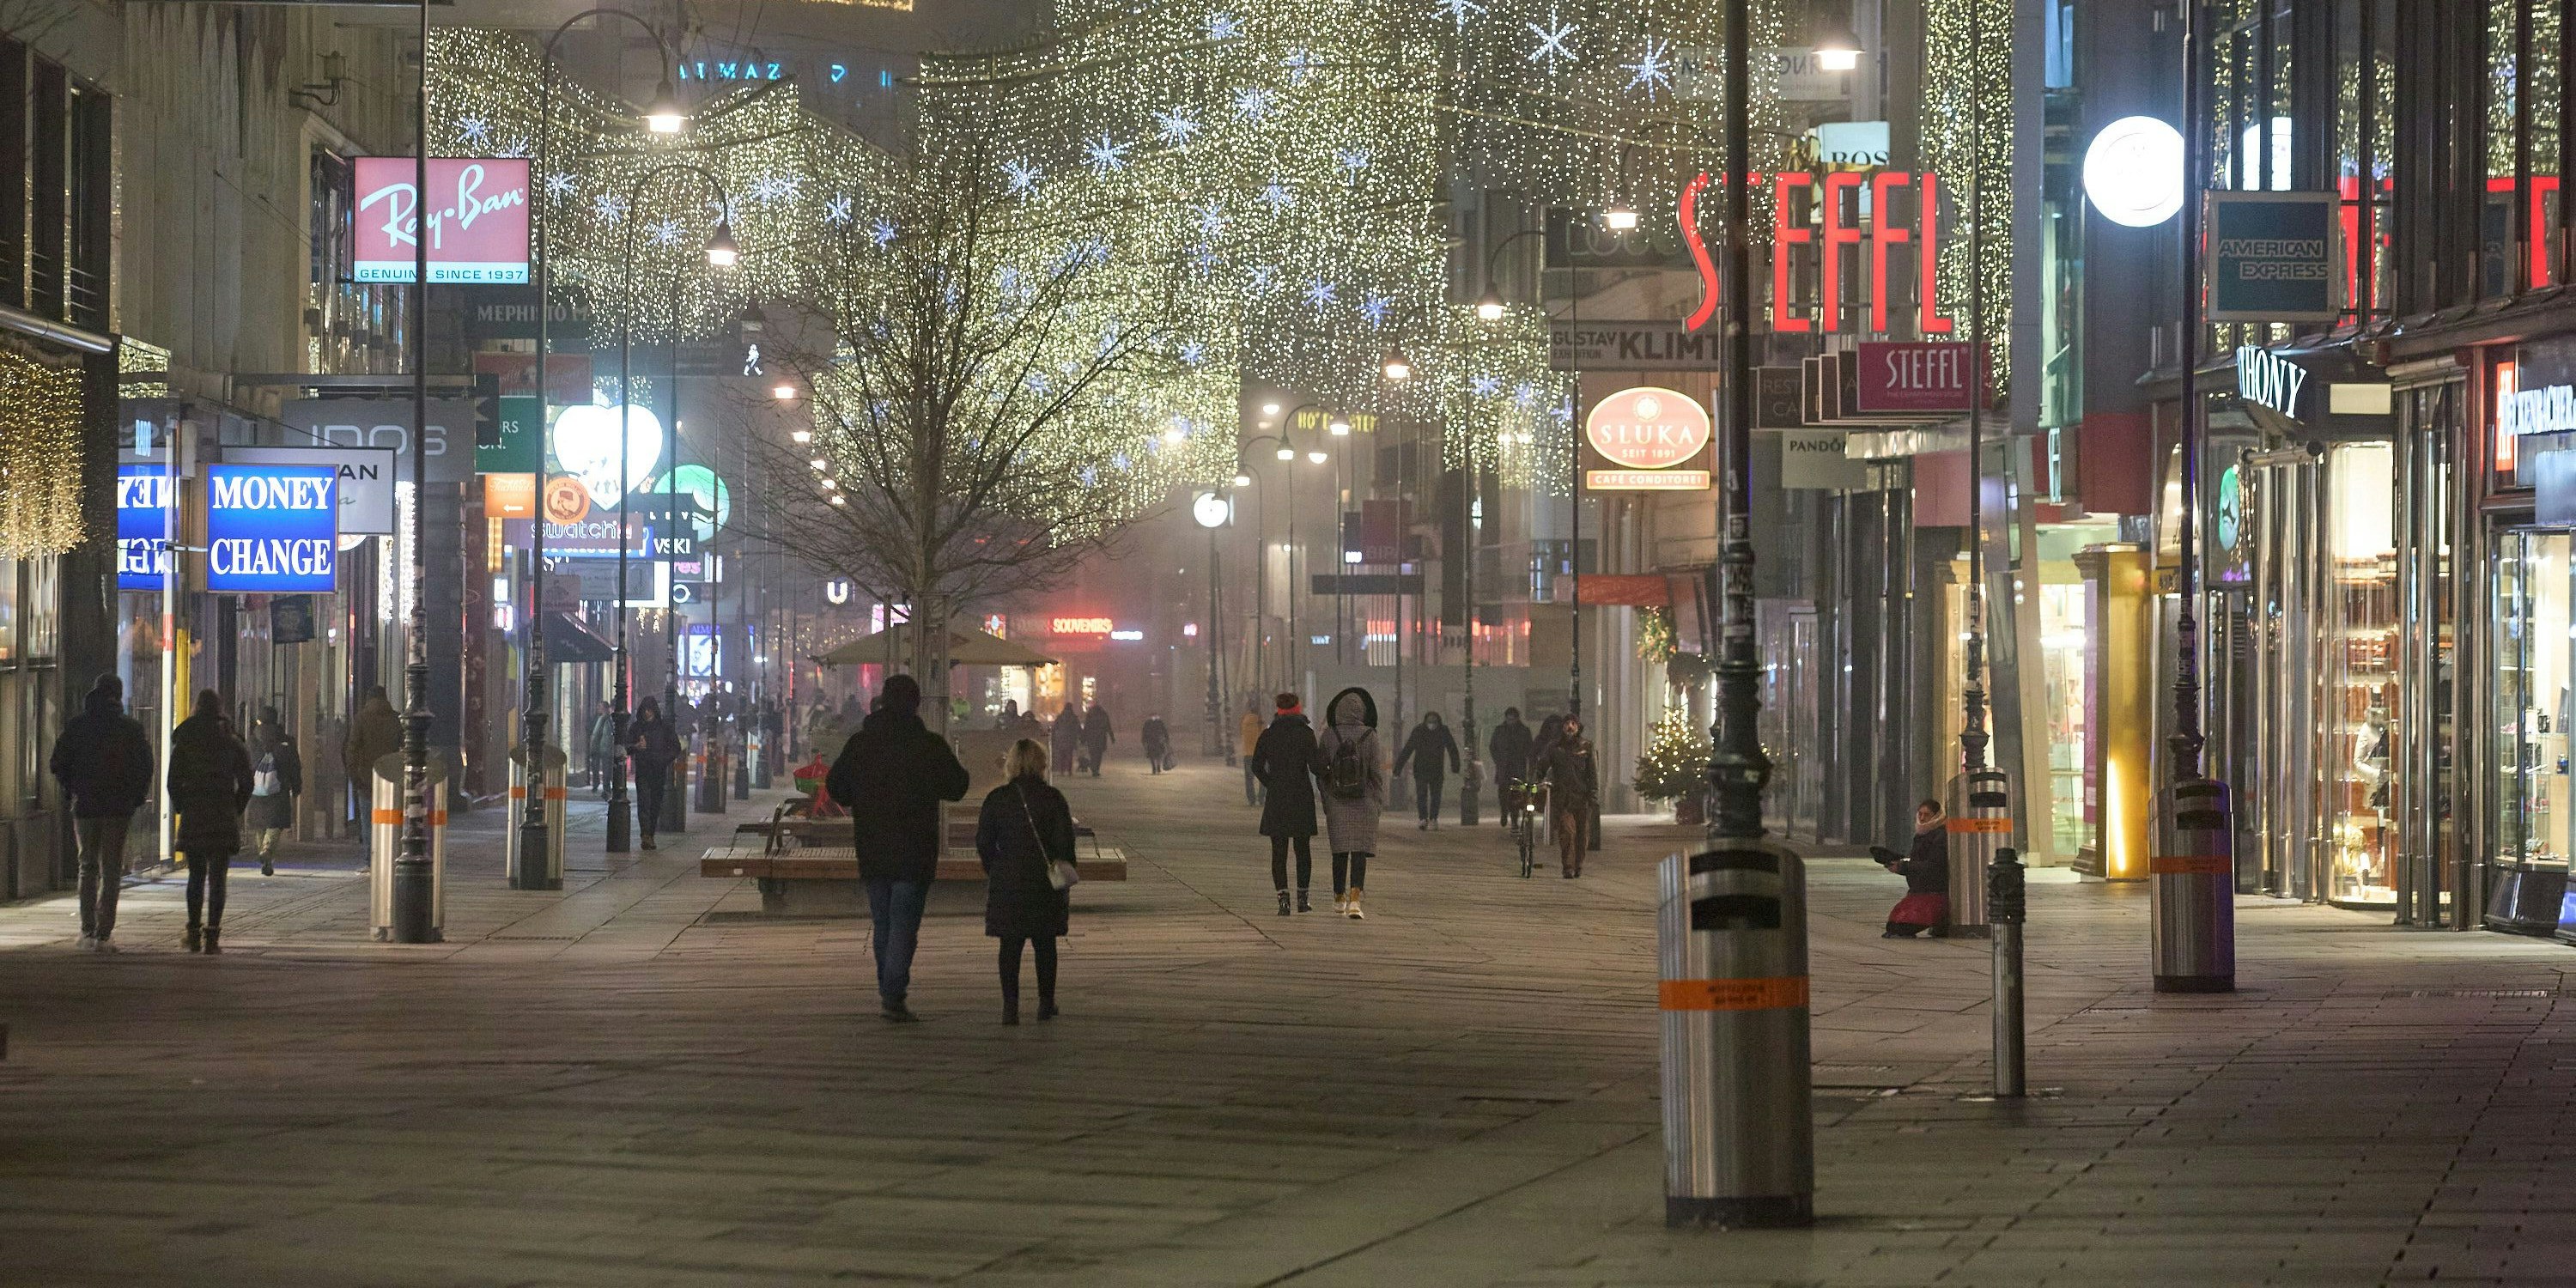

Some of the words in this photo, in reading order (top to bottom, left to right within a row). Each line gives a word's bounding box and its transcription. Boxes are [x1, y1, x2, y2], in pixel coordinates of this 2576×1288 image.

[1680, 171, 1952, 332] SEFFL
[2219, 239, 2324, 258] AMERICAN
[360, 268, 428, 279] GENUIN
[435, 270, 482, 280] SINCE
[488, 270, 524, 281] 1937
[2240, 262, 2328, 280] EXPRESS
[477, 304, 567, 322] MEPHITO
[1552, 331, 1616, 347] GUSTAV
[1886, 349, 1963, 389] STEFFL
[1600, 423, 1696, 447] SLUKA
[1621, 449, 1647, 459] SEIT
[1651, 449, 1675, 459] 1891
[1594, 474, 1625, 484] CAFÉ
[1628, 475, 1702, 485] CONDITOREI
[212, 476, 334, 510] MONEY
[210, 538, 332, 575] CHANGE
[827, 581, 848, 605] U
